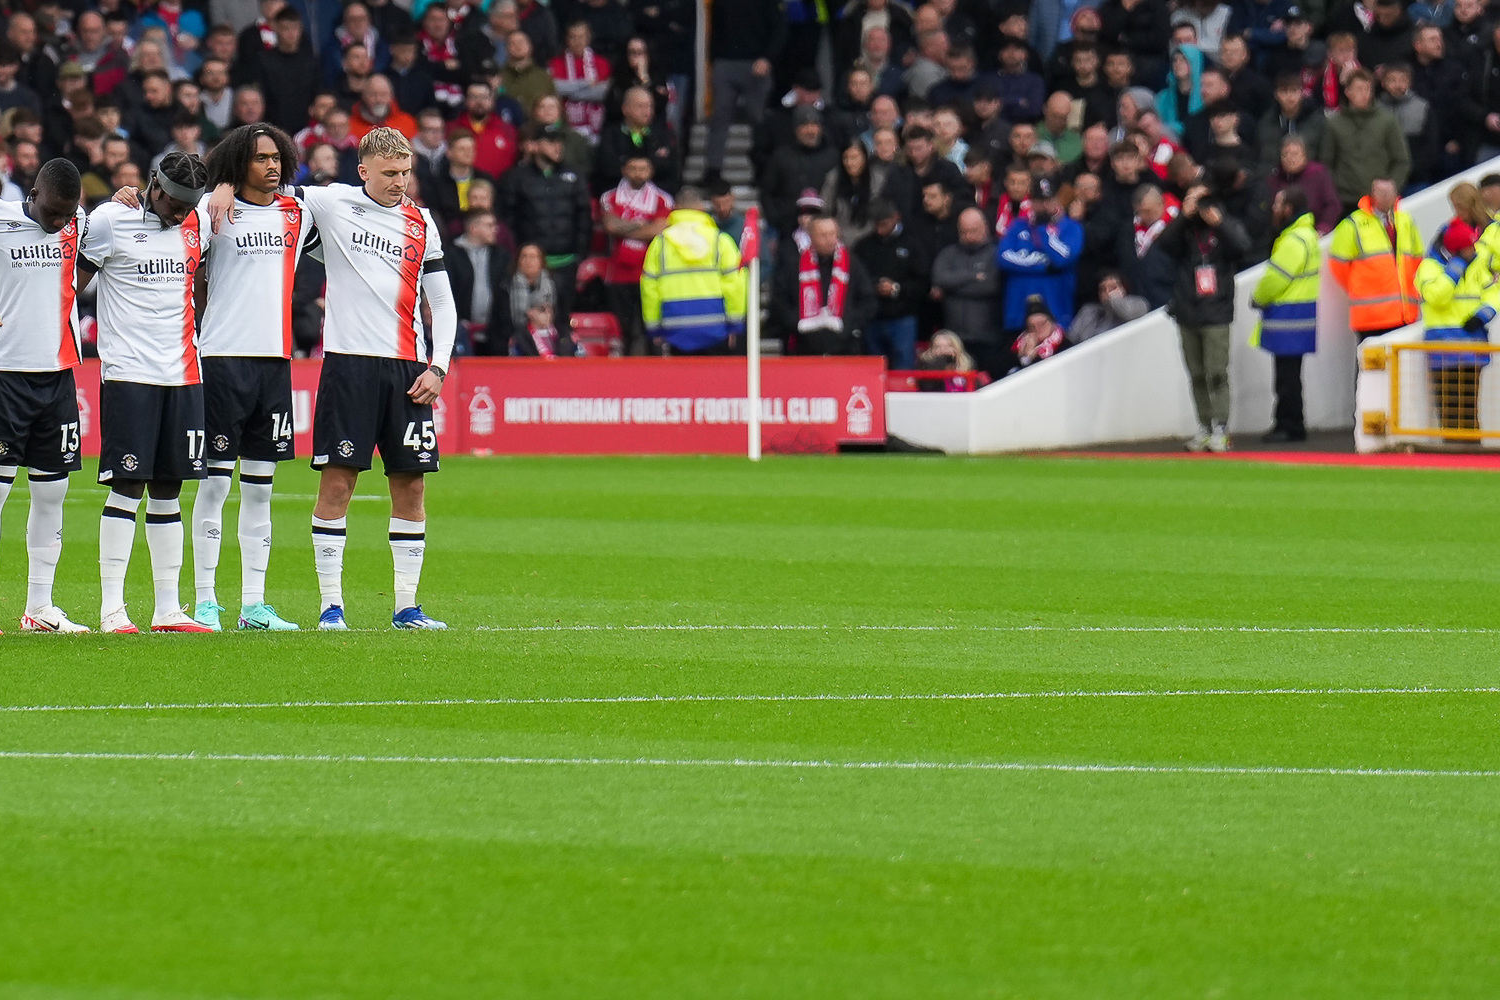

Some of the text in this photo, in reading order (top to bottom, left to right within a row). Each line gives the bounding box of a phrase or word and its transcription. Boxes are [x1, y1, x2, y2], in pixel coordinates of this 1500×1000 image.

[10, 244, 62, 261] utilita
[234, 232, 284, 248] utilita
[352, 231, 403, 258] utilita
[137, 258, 185, 275] utilita
[504, 397, 620, 424] NOTTINGHAM
[622, 397, 692, 423] FOREST
[788, 398, 838, 423] CLUB
[61, 422, 79, 453] 13
[272, 412, 292, 441] 14
[403, 420, 436, 450] 45
[187, 430, 205, 459] 17
